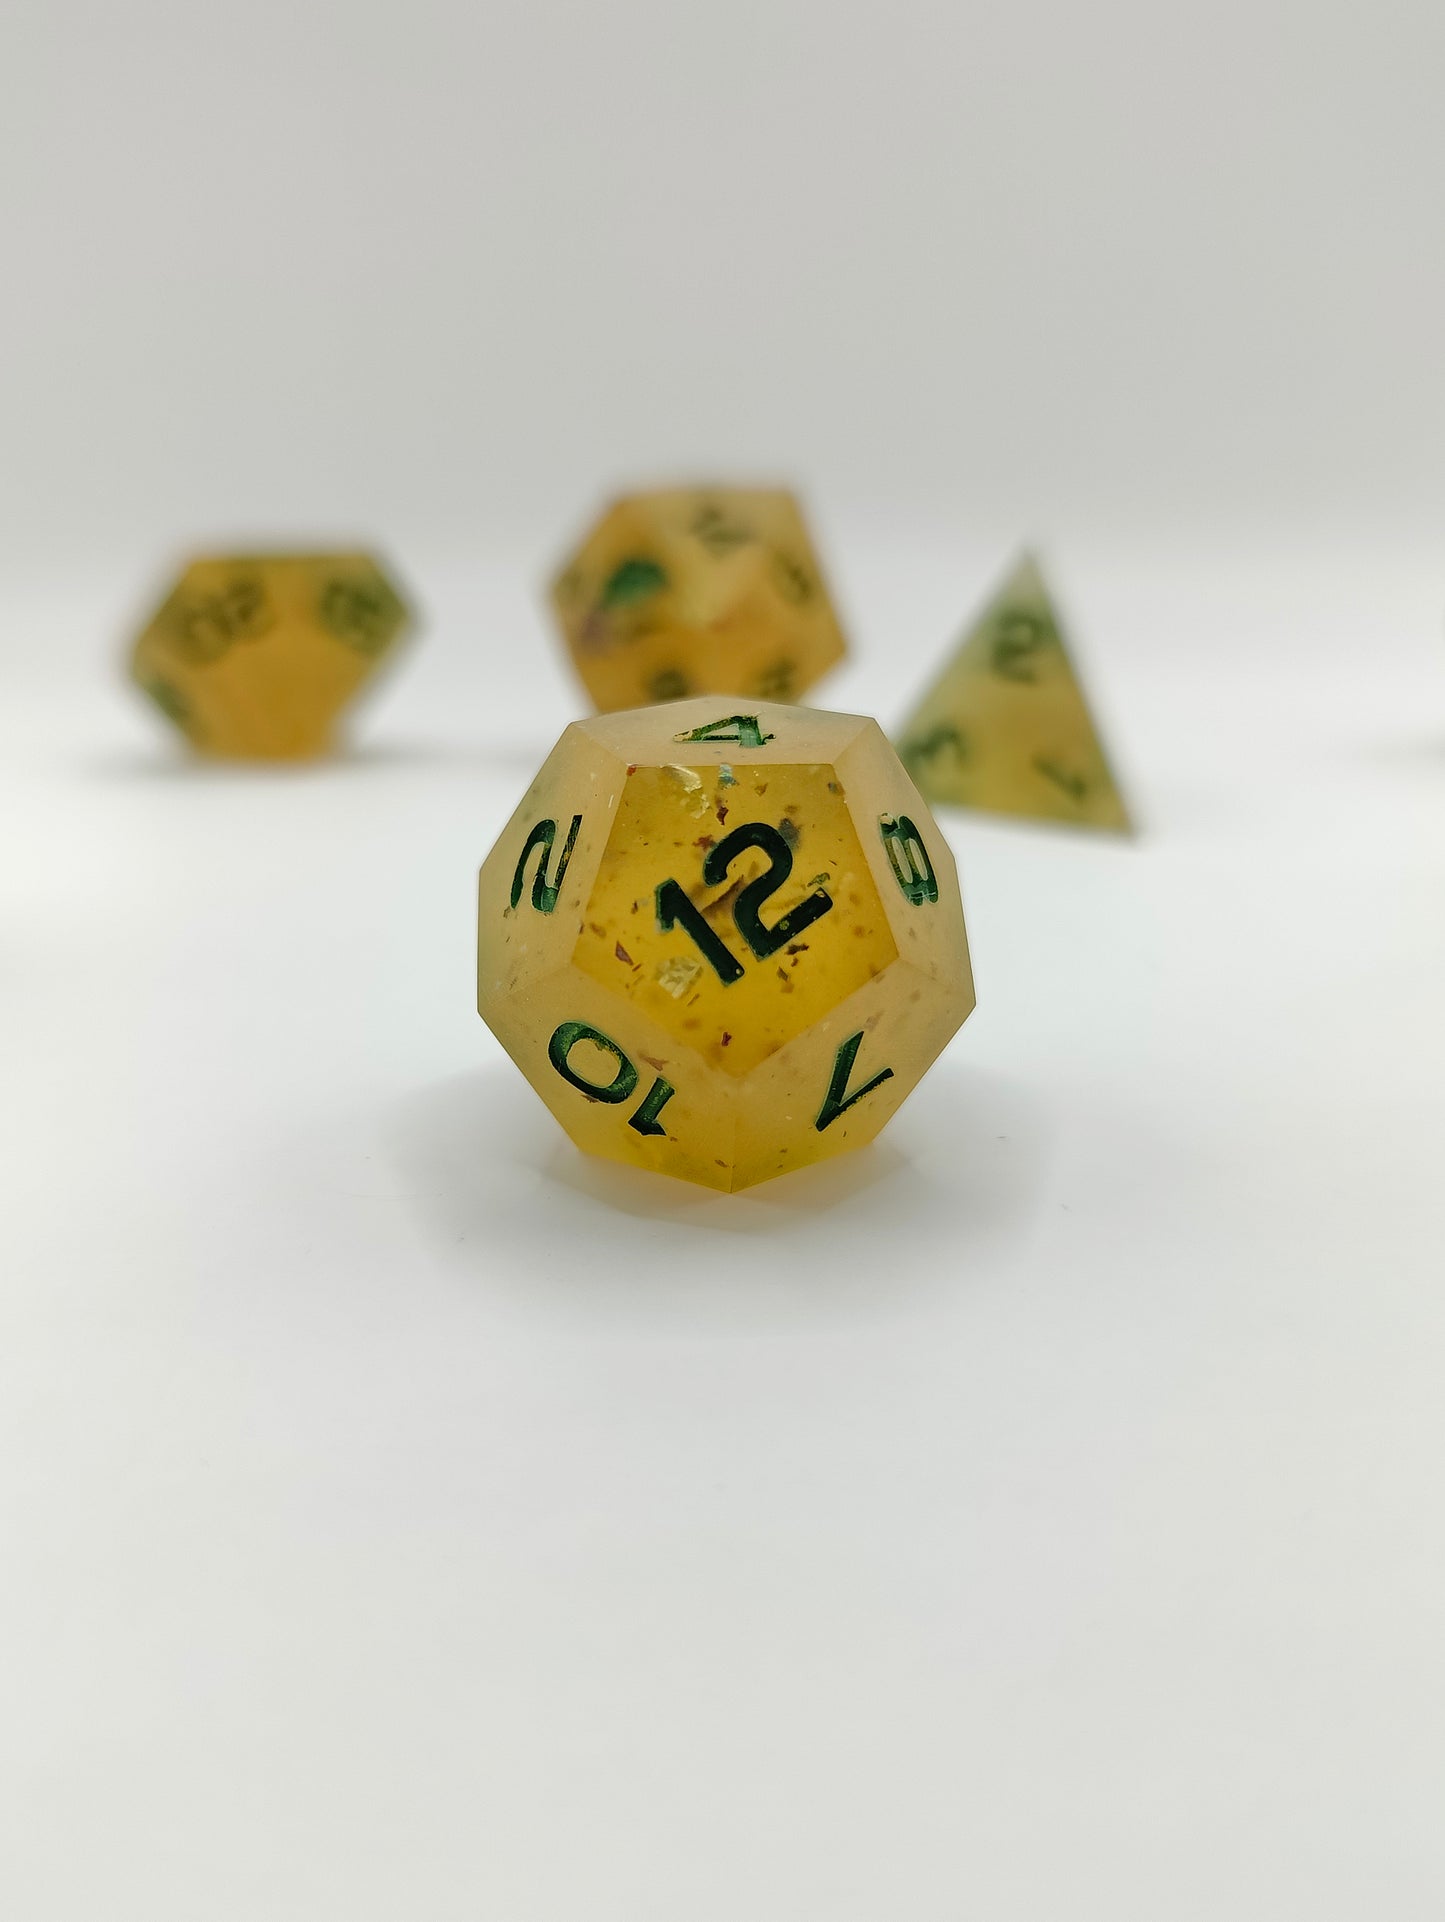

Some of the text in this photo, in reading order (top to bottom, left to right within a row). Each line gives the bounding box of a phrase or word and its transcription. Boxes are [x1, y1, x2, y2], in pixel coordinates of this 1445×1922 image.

[673, 714, 776, 748] 4
[510, 814, 583, 914] 2
[654, 822, 833, 985] 12
[879, 812, 939, 907] 8
[548, 1020, 676, 1136] 10
[814, 1030, 894, 1132] 7
